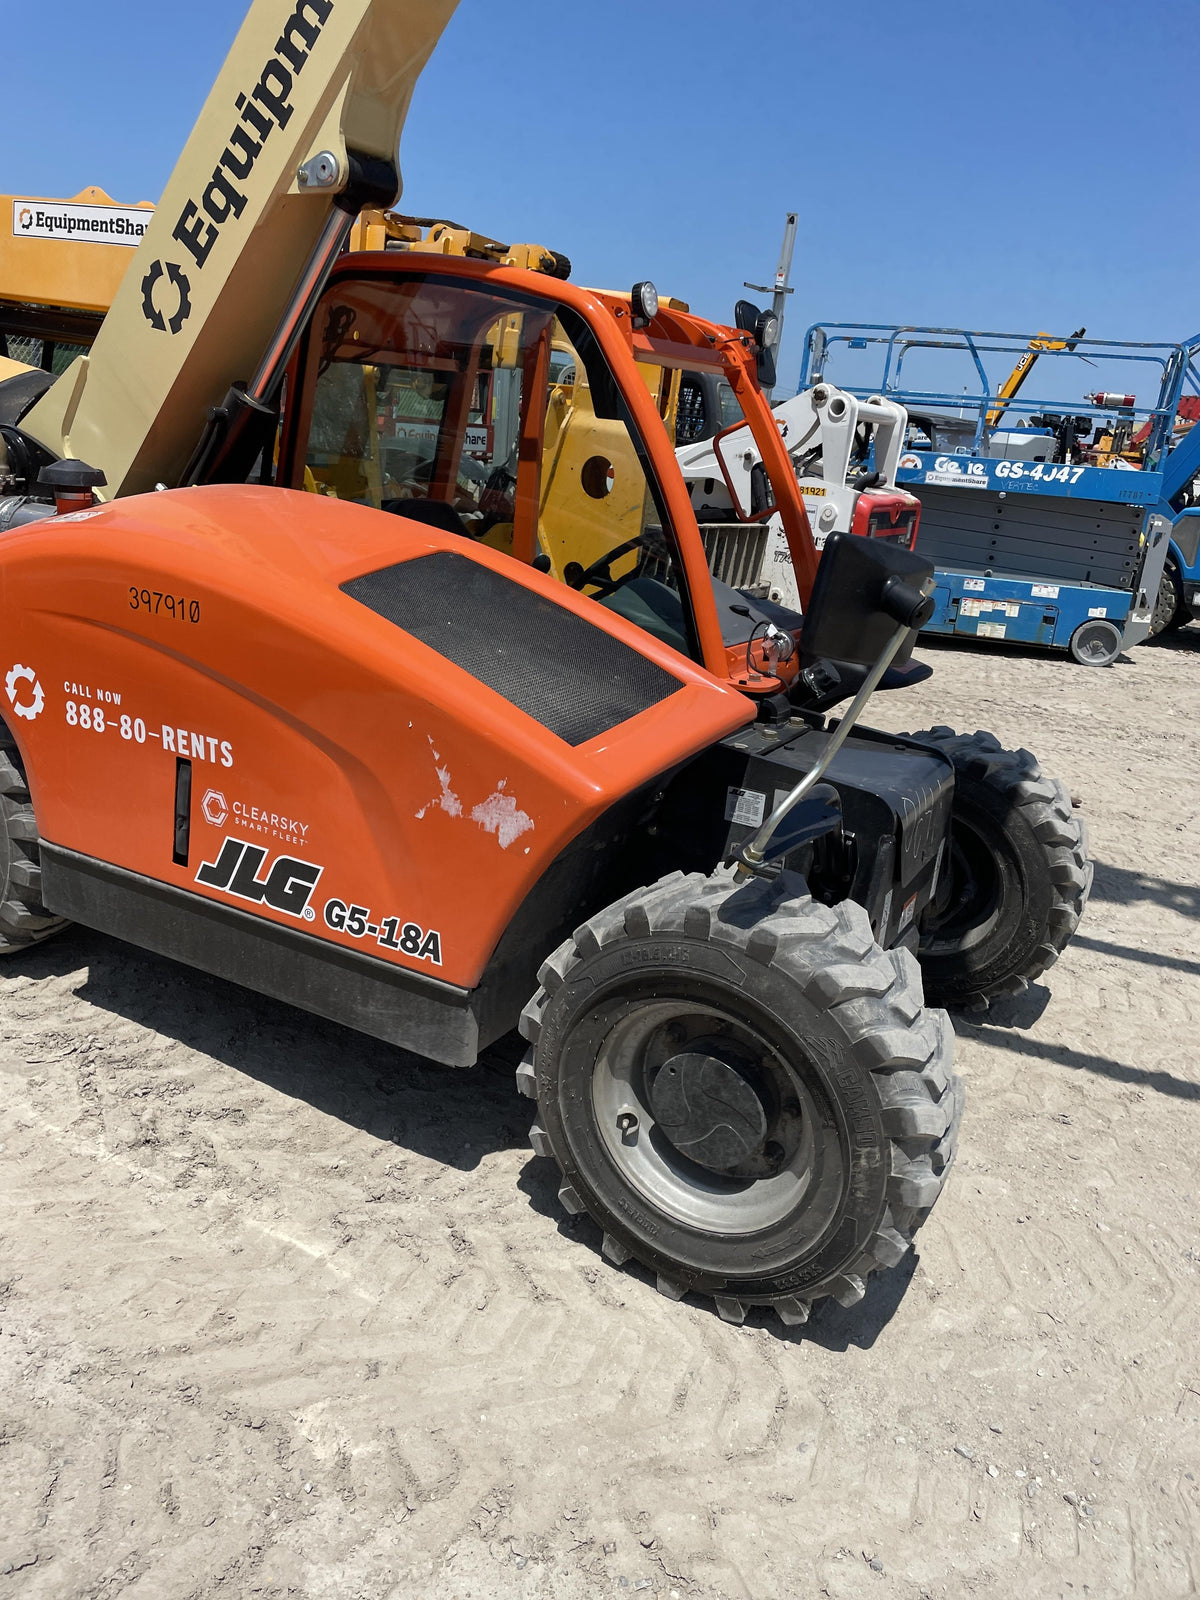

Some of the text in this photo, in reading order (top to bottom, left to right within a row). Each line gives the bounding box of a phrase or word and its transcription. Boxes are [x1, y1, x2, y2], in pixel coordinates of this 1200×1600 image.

[35, 211, 149, 237] EquipmentSha
[934, 456, 985, 477] Geie
[129, 586, 200, 623] 397910
[63, 681, 121, 705] CALL NOW
[65, 700, 234, 768] 888-80-RENTS
[232, 801, 309, 836] CLEARSKY
[234, 817, 269, 834] SMART
[193, 836, 325, 919] JLG
[323, 897, 443, 967] G5-18A
